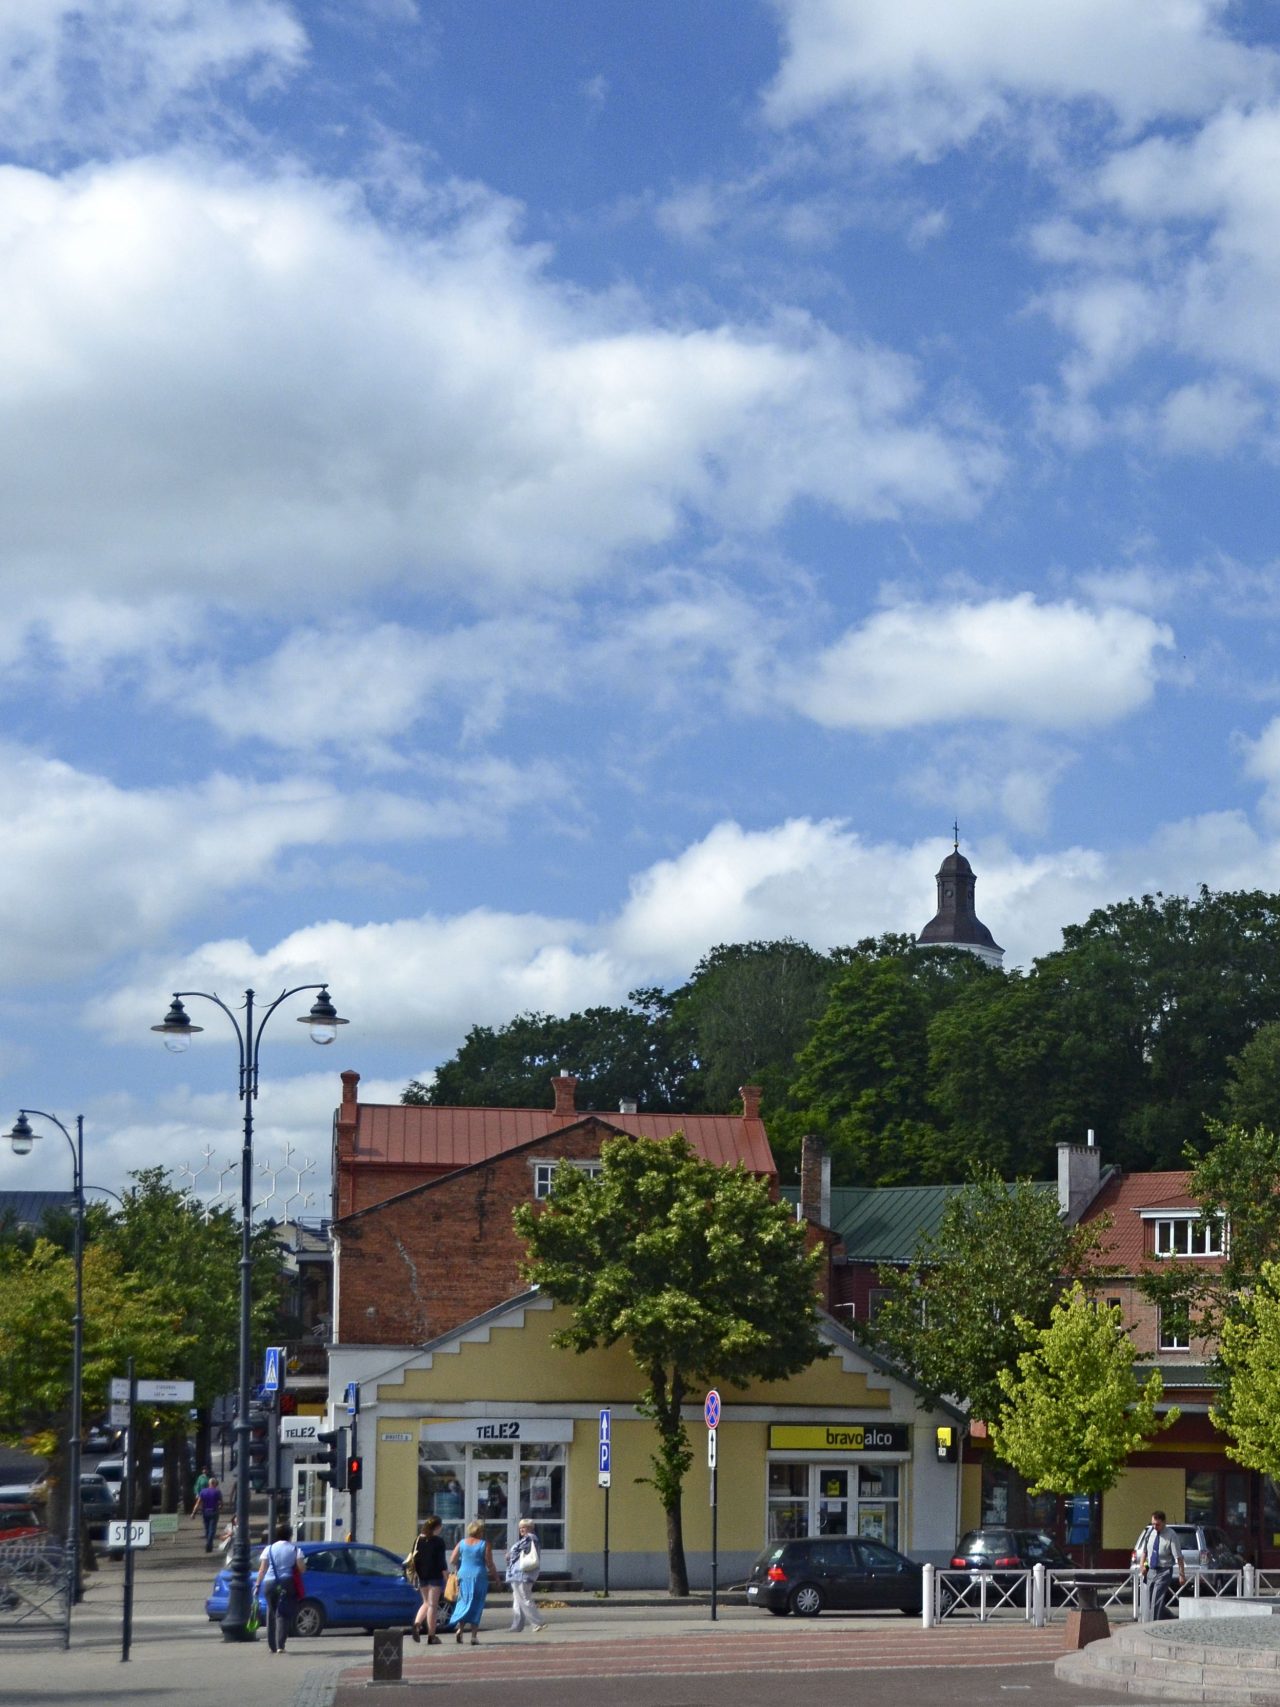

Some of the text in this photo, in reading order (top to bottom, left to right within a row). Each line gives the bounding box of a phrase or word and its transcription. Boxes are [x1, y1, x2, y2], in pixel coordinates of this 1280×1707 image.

[285, 1426, 316, 1438] TELE2
[476, 1421, 520, 1439] TELE2
[826, 1427, 893, 1446] bravoalco
[601, 1444, 608, 1470] P
[115, 1526, 144, 1541] STOP
